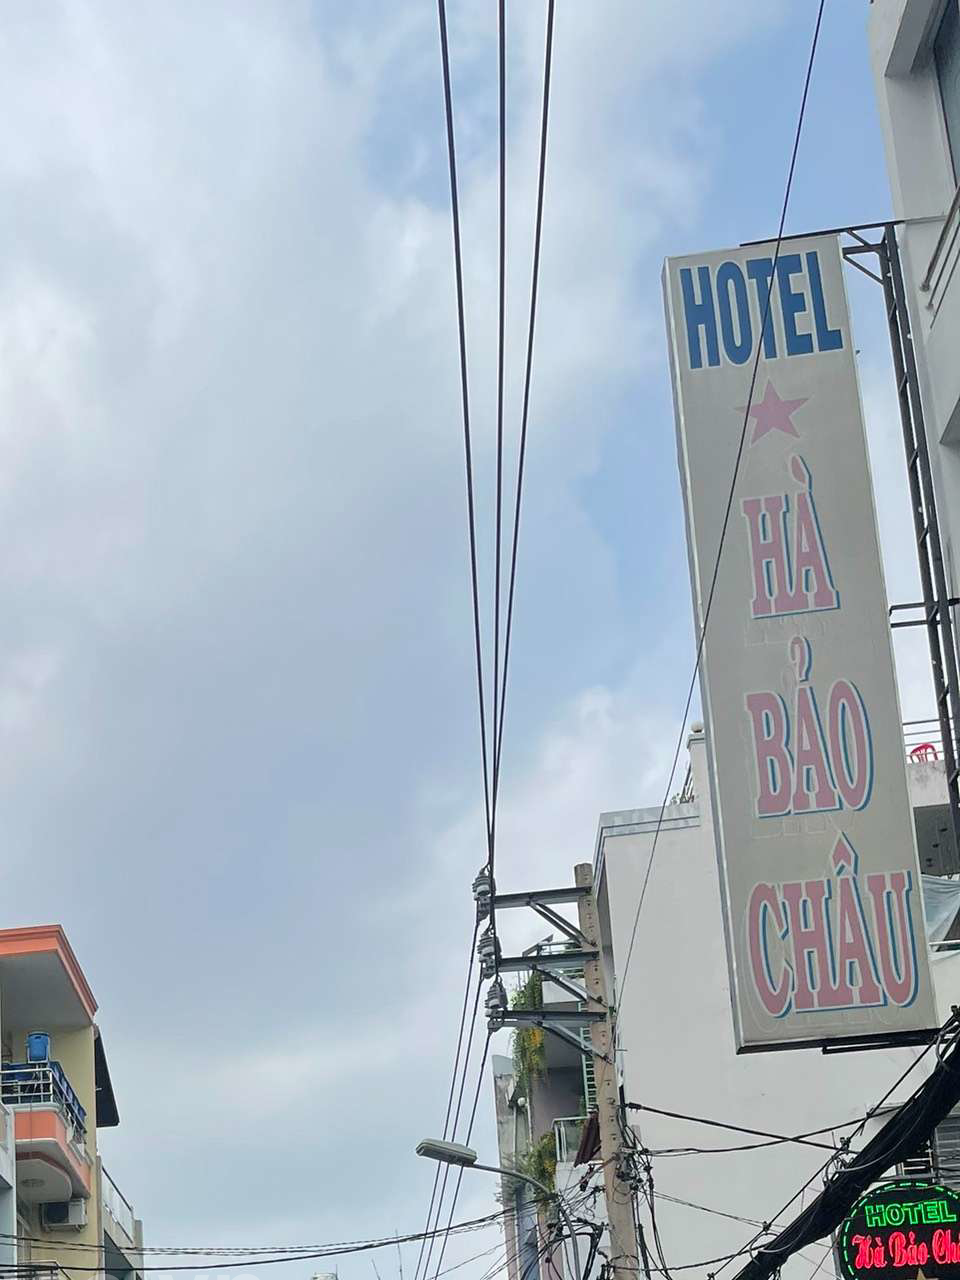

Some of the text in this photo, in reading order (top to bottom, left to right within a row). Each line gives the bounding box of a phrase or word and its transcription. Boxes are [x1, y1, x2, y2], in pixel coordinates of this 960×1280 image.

[680, 251, 843, 369] HOTEL
[742, 455, 840, 620] HÀ
[745, 636, 874, 818] BẢO
[748, 832, 918, 1019] CHÂU
[865, 1201, 957, 1227] HOTEL
[889, 1231, 929, 1267] Bảo
